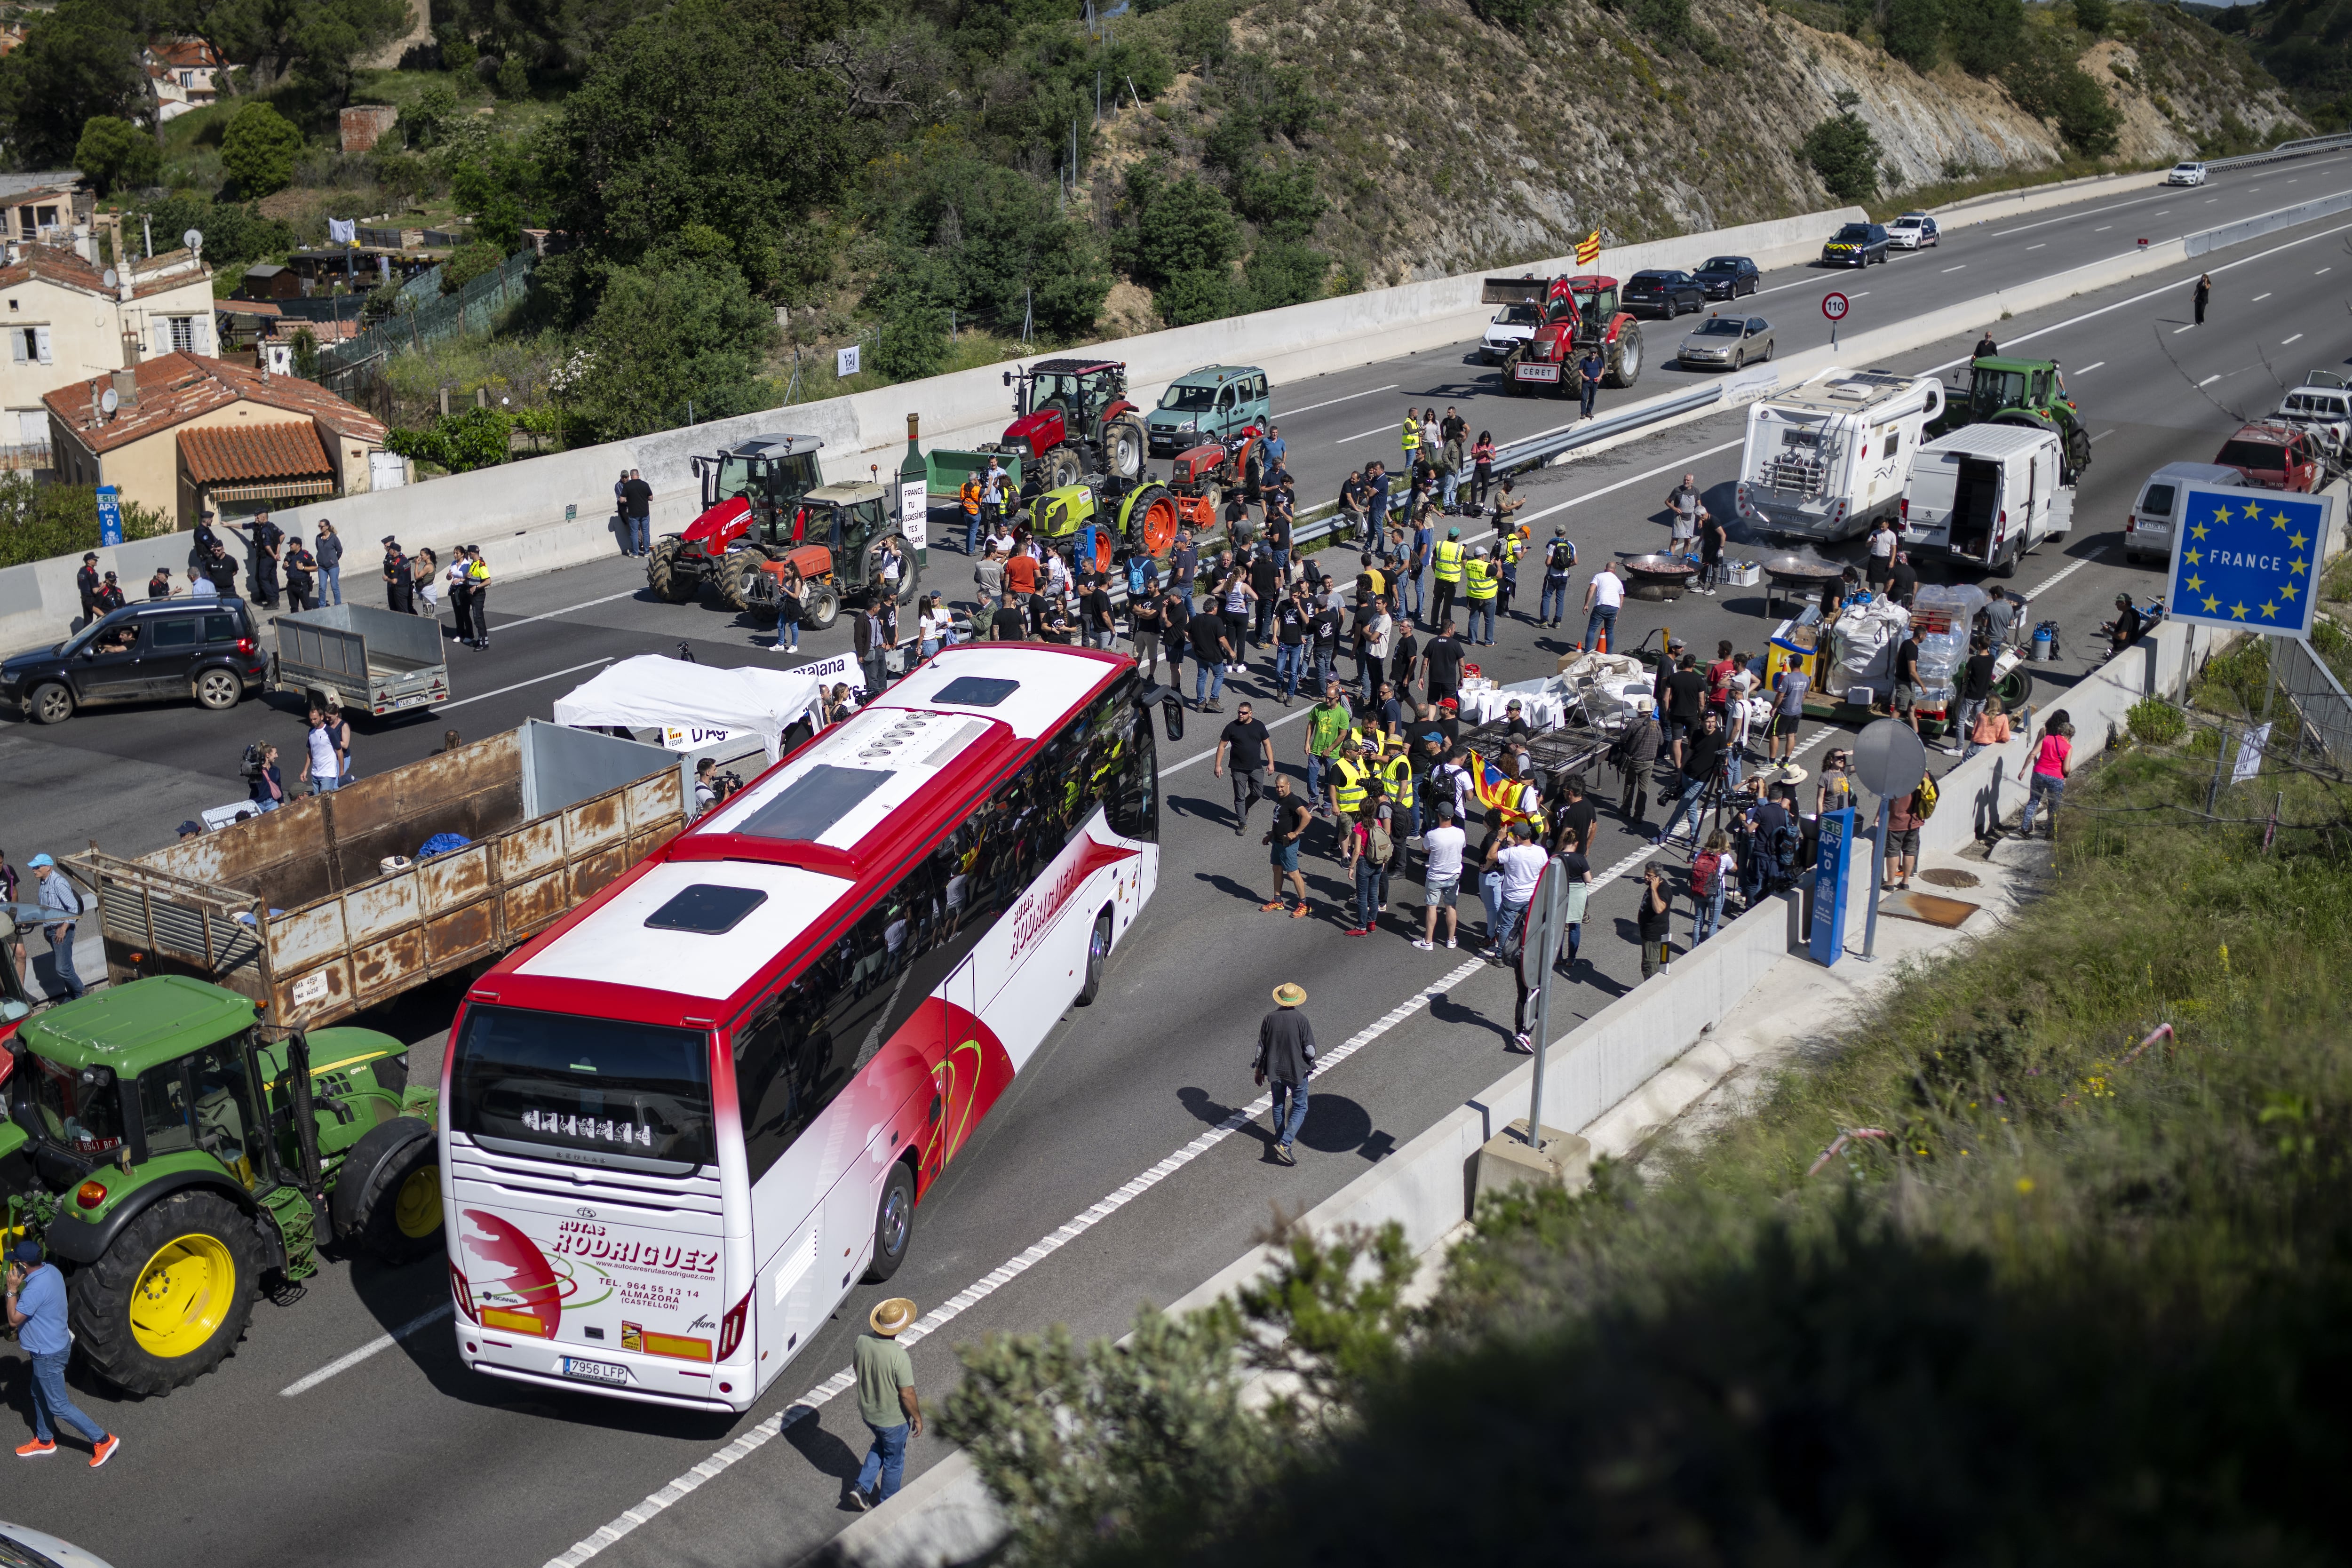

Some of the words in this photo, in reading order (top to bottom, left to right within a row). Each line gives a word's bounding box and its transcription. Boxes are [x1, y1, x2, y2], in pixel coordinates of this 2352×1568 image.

[1828, 301, 1844, 311] 110
[1524, 367, 1551, 376] CÉRET
[904, 487, 924, 497] FRANCE
[908, 525, 918, 533] TES
[1075, 534, 1087, 542] E-15
[1074, 542, 1088, 552] AP-7
[2210, 549, 2281, 571] FRANCE
[669, 738, 683, 747] FEDAR
[1821, 819, 1841, 835] E-15
[1819, 831, 1842, 849] AP-7
[1823, 849, 1834, 859] km
[1824, 859, 1832, 870] 0
[1010, 860, 1075, 960] RODRIGUEZ
[1013, 893, 1033, 926] RUTAS
[307, 976, 318, 984] 4250
[83, 1140, 100, 1151] 8541
[556, 1152, 606, 1164] BEULAS
[559, 1220, 606, 1236] RUTAS
[552, 1234, 718, 1274] RODRIGUEZ
[596, 1259, 715, 1281] www.autocaresrutasrodriguez.com
[599, 1277, 622, 1288] TEL.
[627, 1281, 646, 1290] 964
[620, 1289, 680, 1304] ALMAZORA
[621, 1297, 678, 1311] (CASTELLON)
[686, 1313, 716, 1333] Aura
[572, 1360, 600, 1375] 7956
[604, 1366, 624, 1378] LFP
